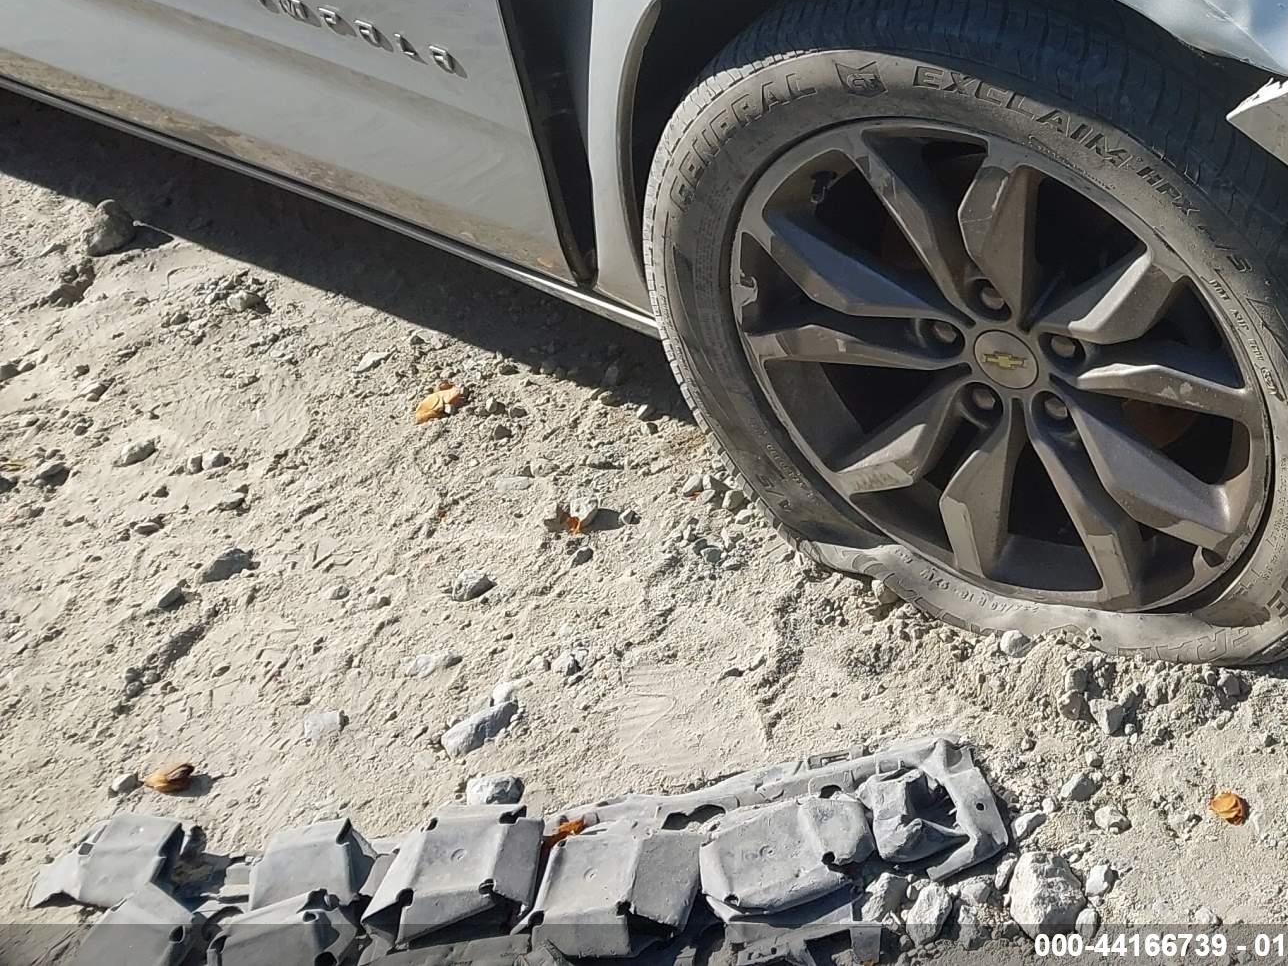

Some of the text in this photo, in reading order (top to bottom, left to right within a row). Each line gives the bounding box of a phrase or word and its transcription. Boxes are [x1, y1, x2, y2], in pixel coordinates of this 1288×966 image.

[669, 72, 818, 214] GENERAL
[912, 65, 1134, 170] EXCLAIM
[1135, 166, 1201, 217] HPX
